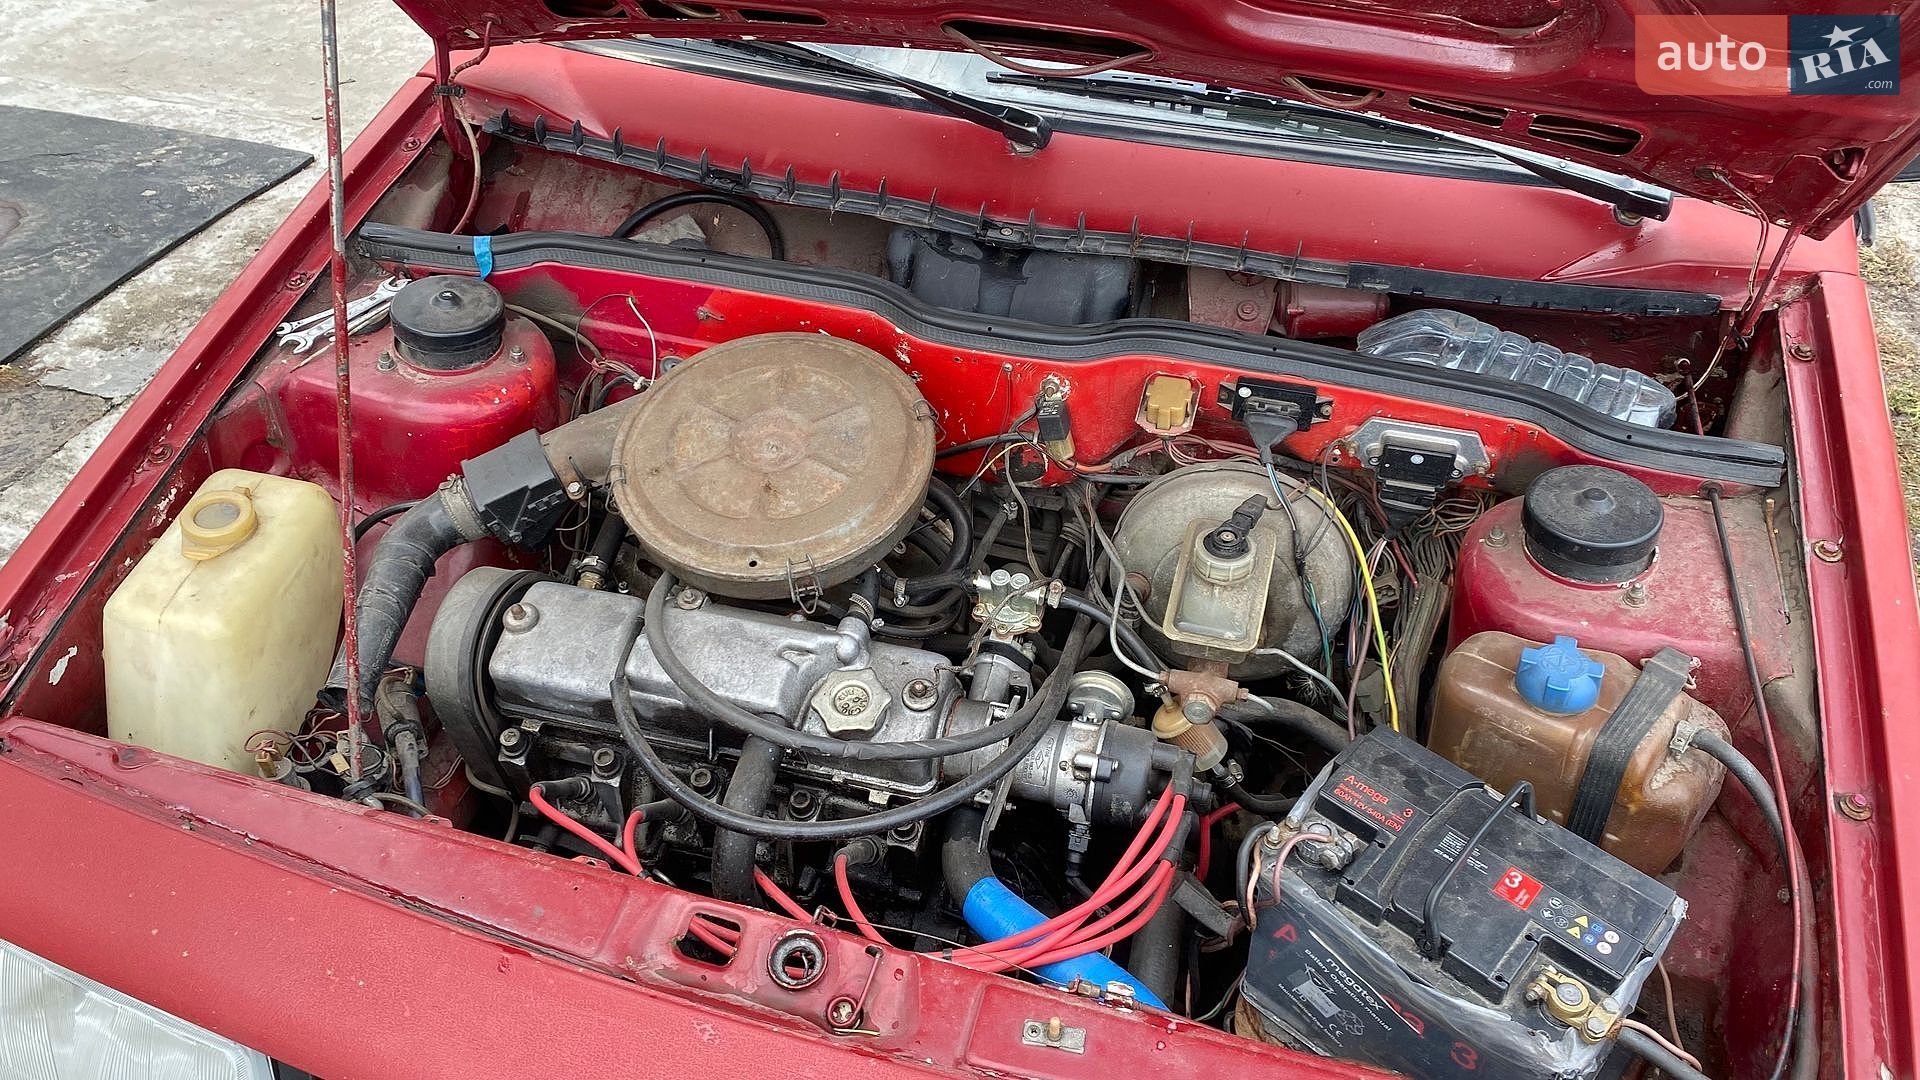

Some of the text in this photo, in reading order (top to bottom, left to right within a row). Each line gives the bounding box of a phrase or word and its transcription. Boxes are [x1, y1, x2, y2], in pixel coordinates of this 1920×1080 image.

[1343, 775, 1390, 805] A-mega
[1403, 808, 1414, 818] 3
[1504, 871, 1523, 889] 3
[1325, 957, 1385, 1011] megatex
[1364, 1006, 1393, 1031] manual
[1450, 1040, 1479, 1071] 3
